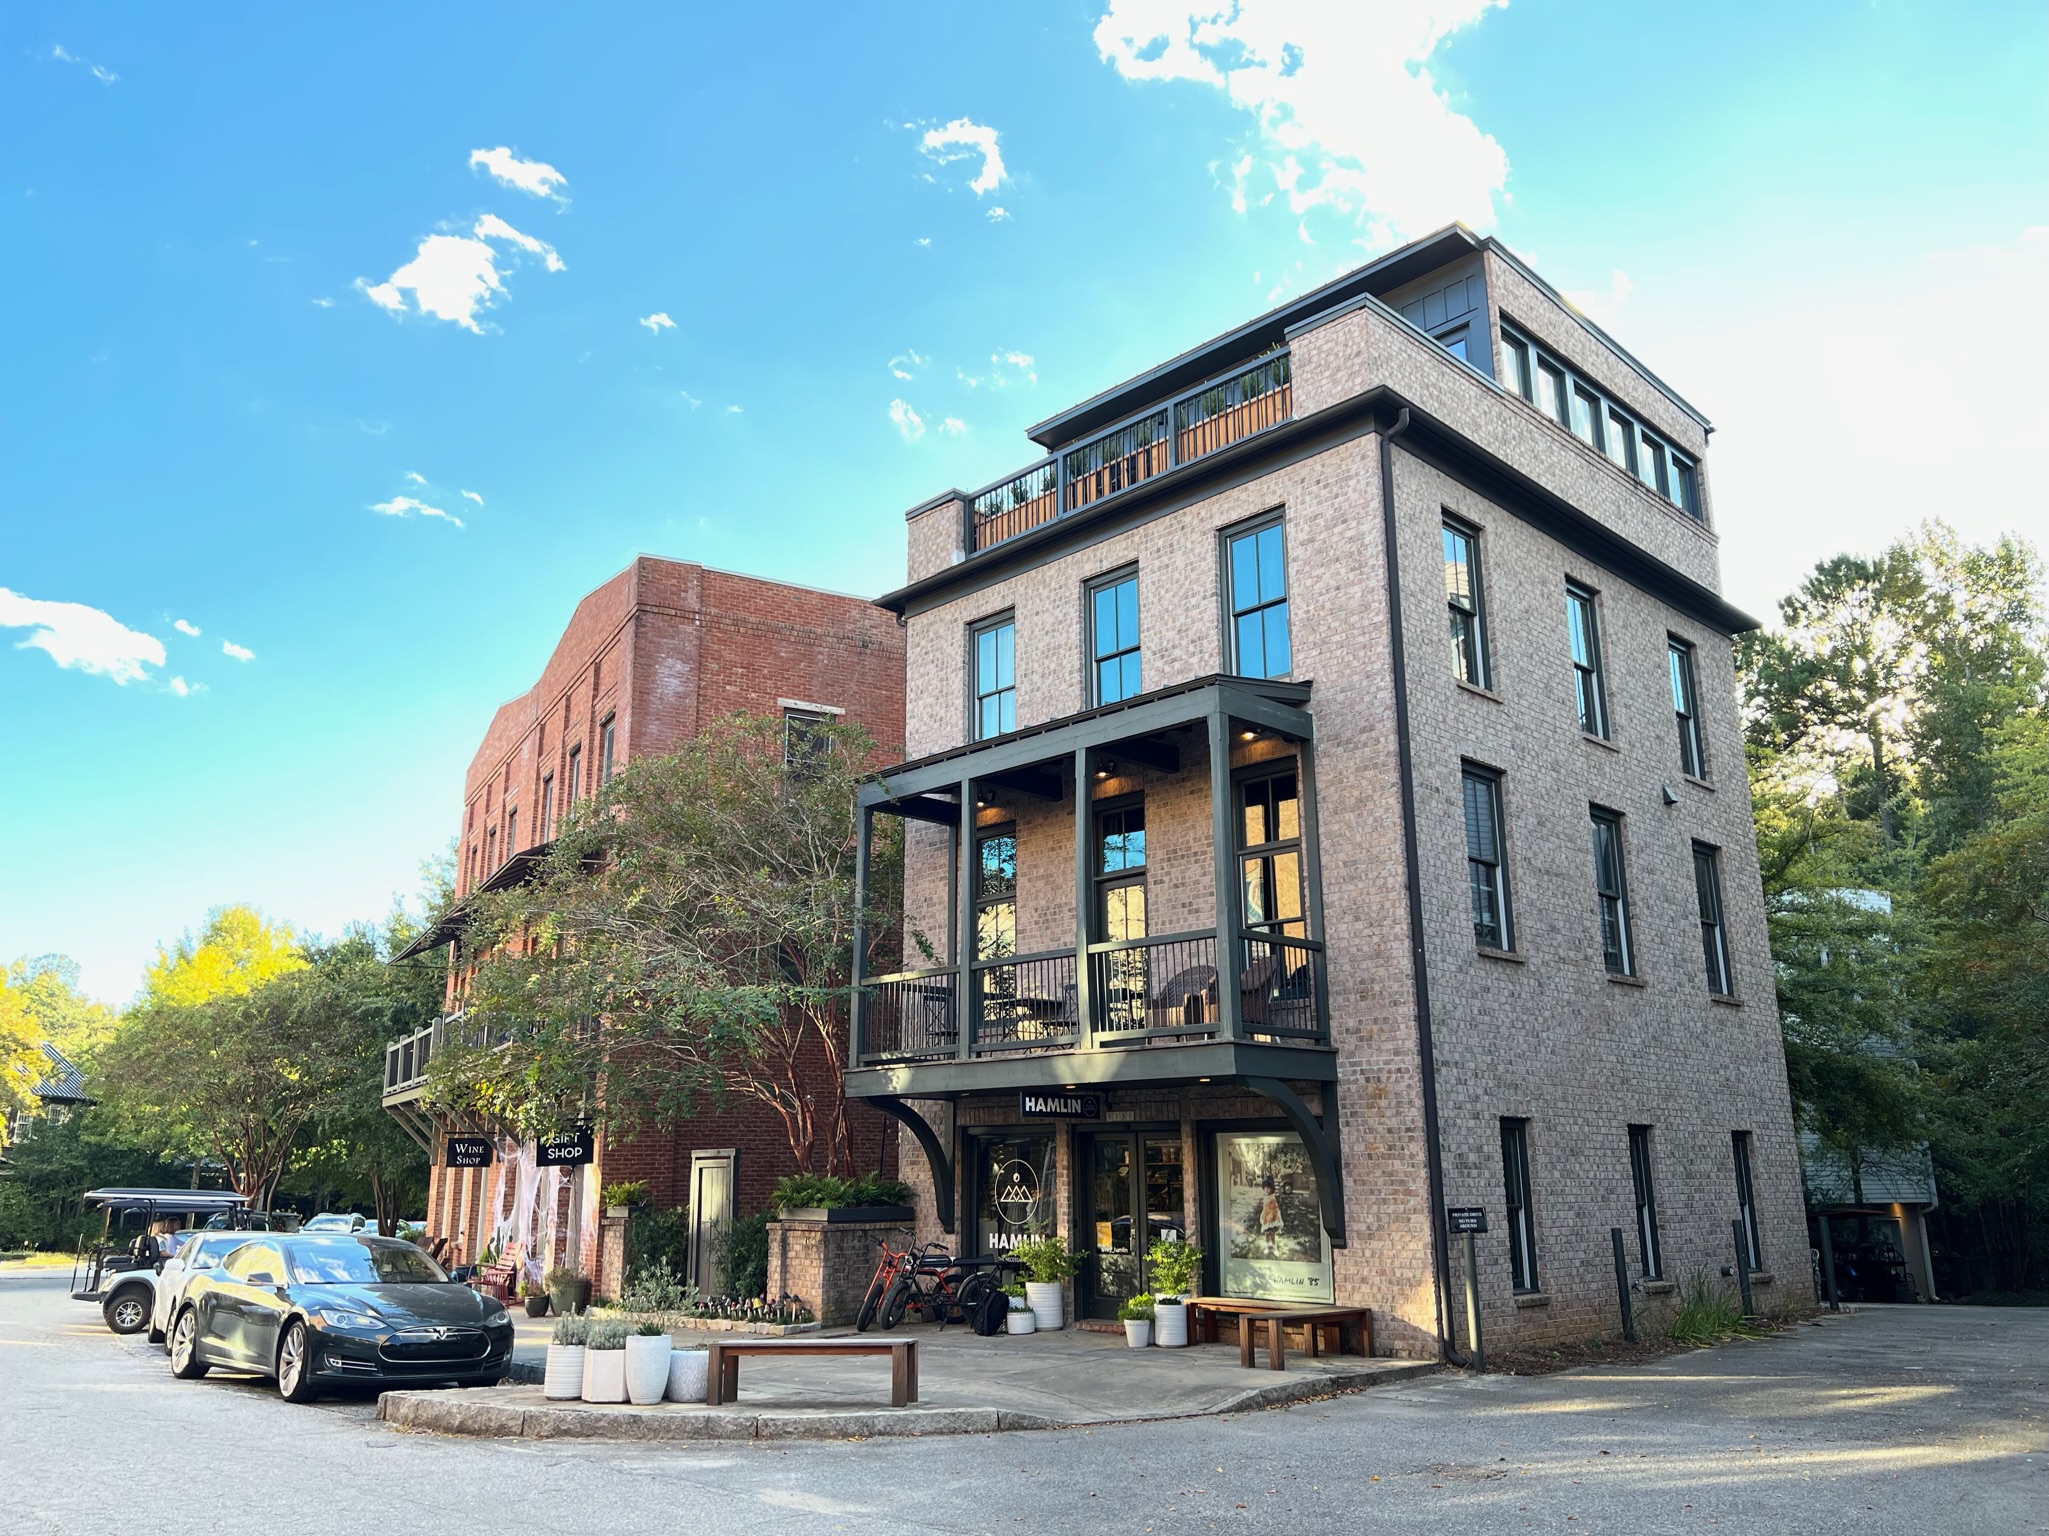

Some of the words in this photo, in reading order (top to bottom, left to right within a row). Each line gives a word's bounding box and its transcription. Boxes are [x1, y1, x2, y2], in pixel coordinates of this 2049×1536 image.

[1025, 1097, 1081, 1113] HAMLIN
[547, 1147, 583, 1159] SHOP
[1273, 1276, 1304, 1286] HAMLIN
